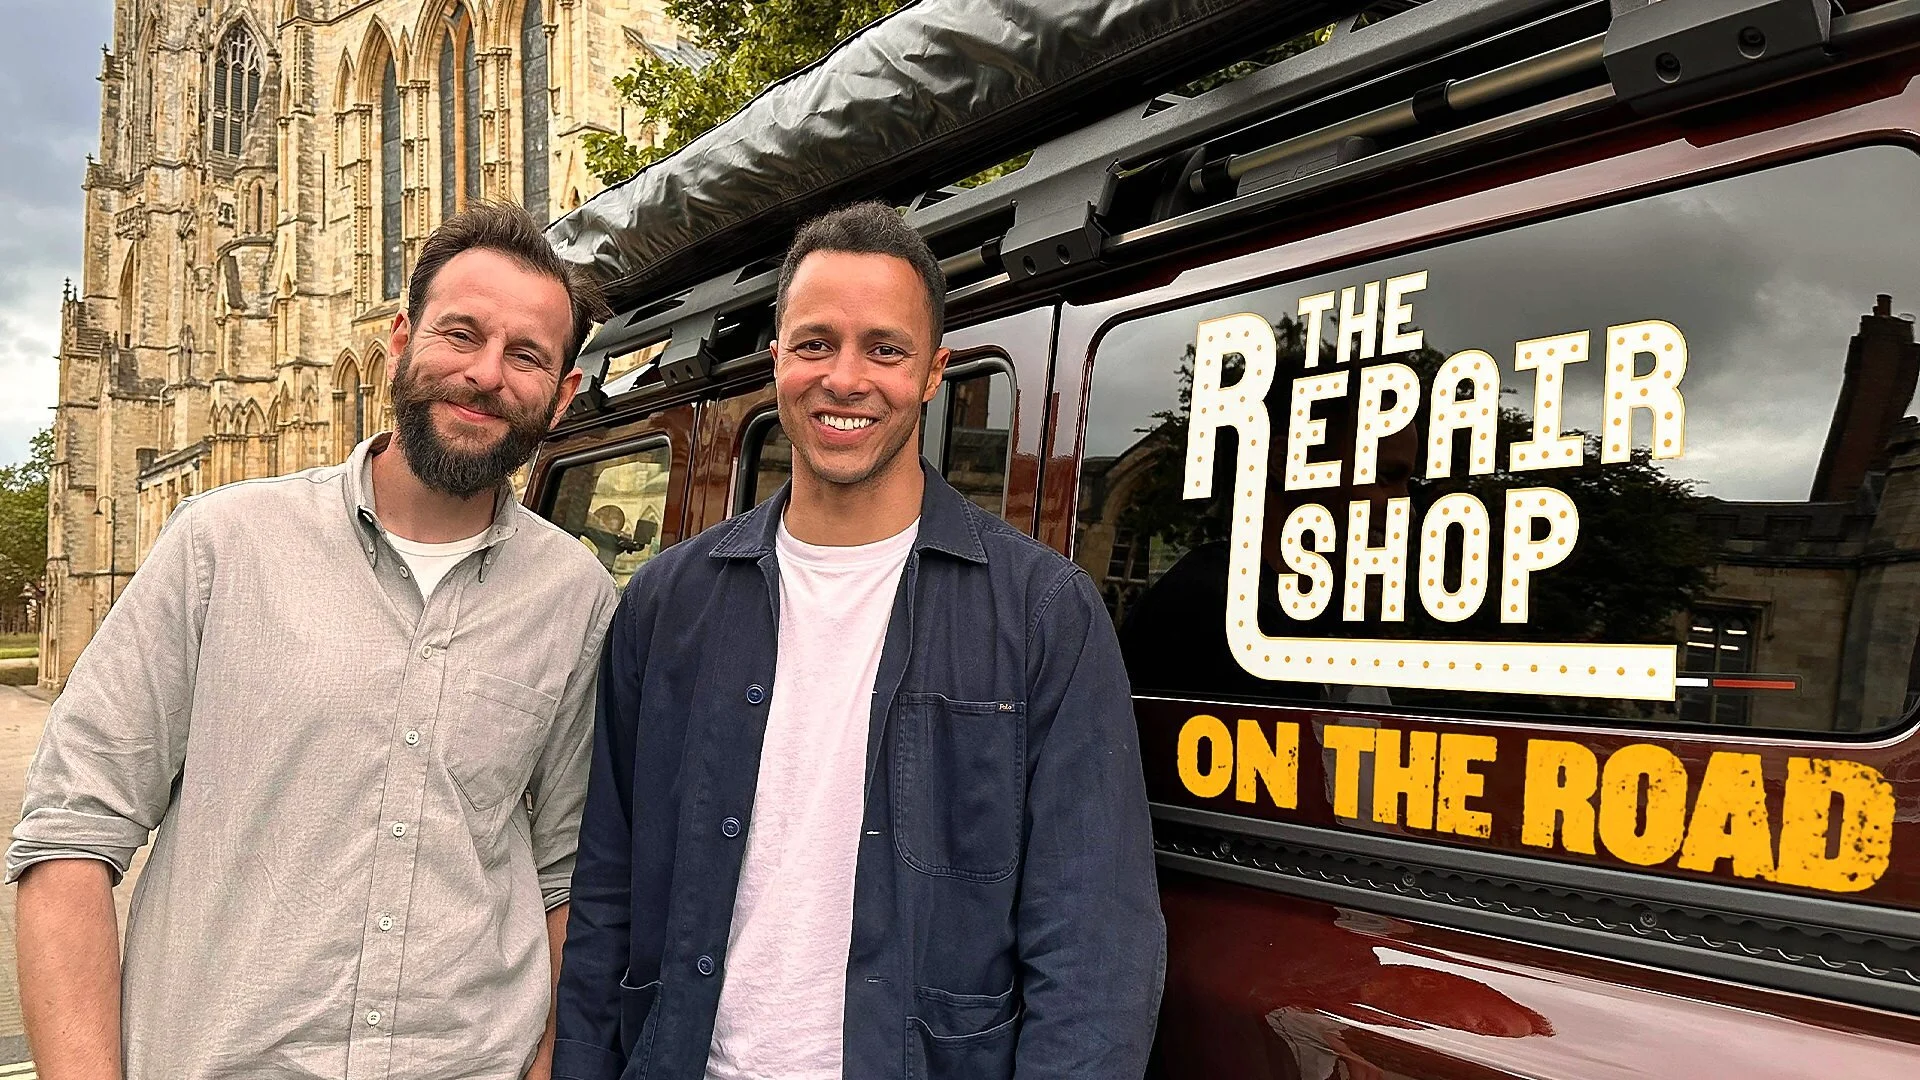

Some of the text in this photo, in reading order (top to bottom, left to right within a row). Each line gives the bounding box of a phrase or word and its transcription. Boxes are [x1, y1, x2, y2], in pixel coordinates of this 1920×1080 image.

[1298, 270, 1428, 368] THE
[1183, 312, 1687, 500] REPAIR
[1278, 487, 1580, 623] SHOP
[1177, 715, 1896, 892] ON THE ROAD
